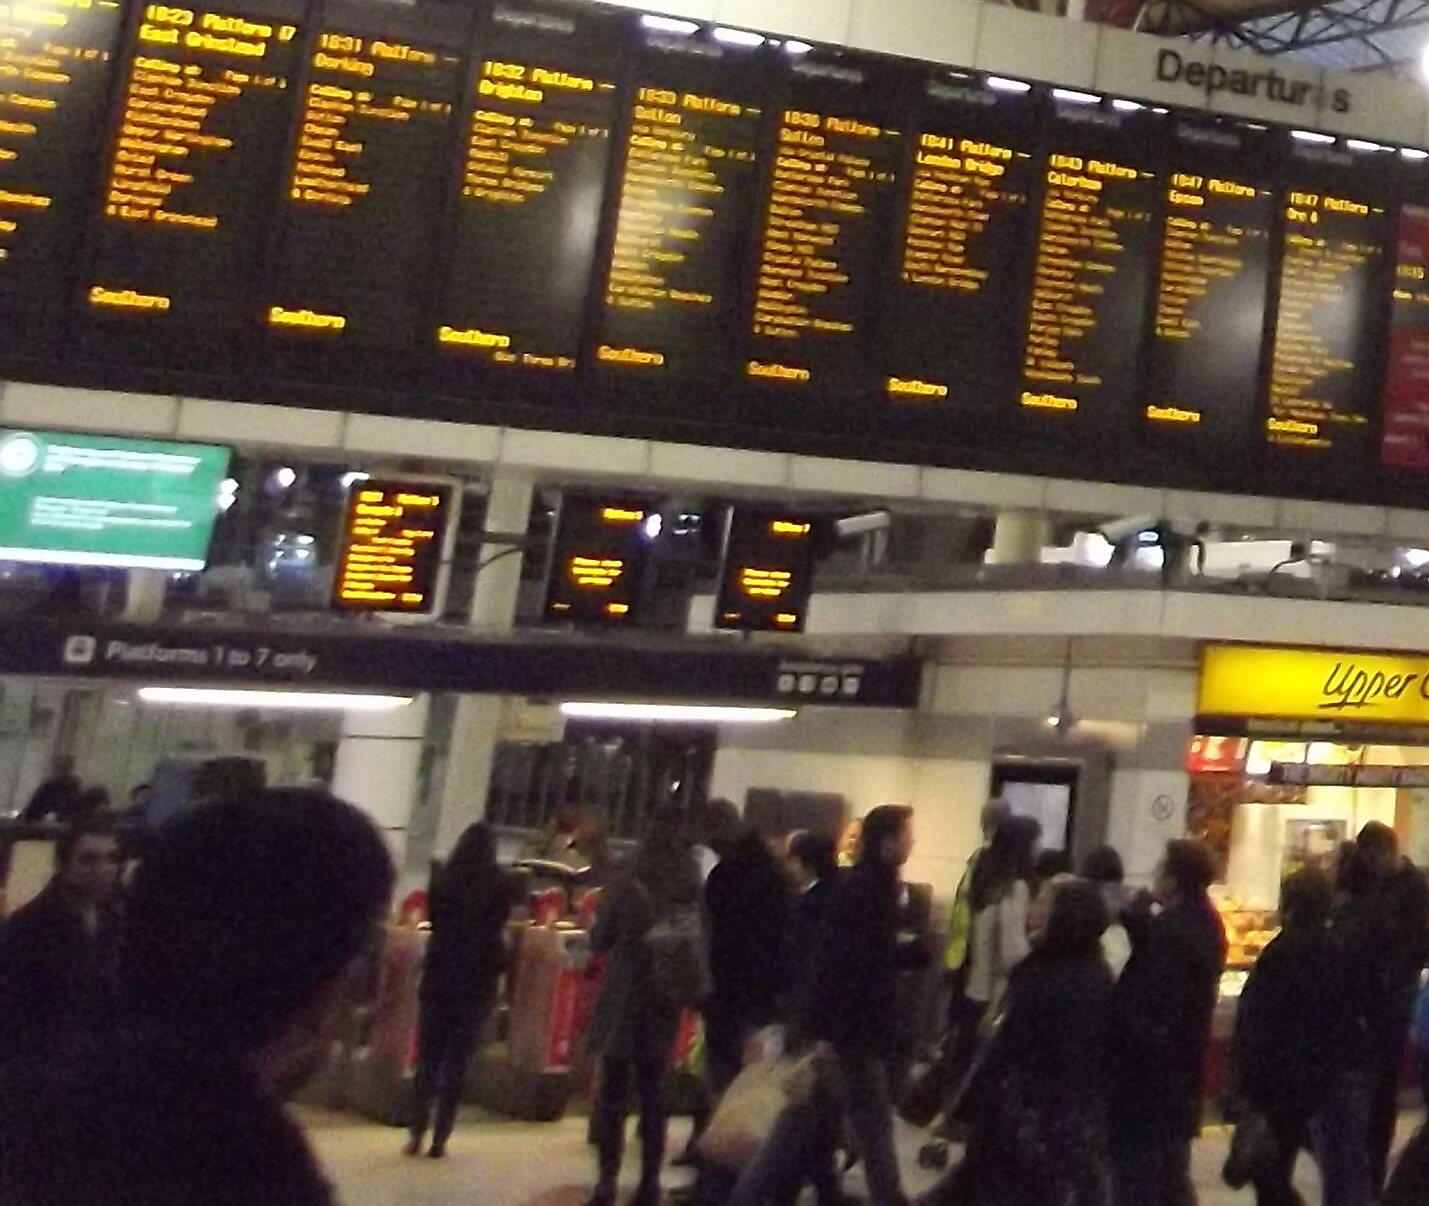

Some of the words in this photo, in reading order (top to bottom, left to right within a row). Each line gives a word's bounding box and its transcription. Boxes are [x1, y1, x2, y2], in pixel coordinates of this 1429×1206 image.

[1156, 48, 1349, 113] Departurs
[106, 640, 208, 664] Platforms
[255, 647, 271, 666] 7
[273, 651, 317, 673] only
[1319, 663, 1417, 708] Upper
